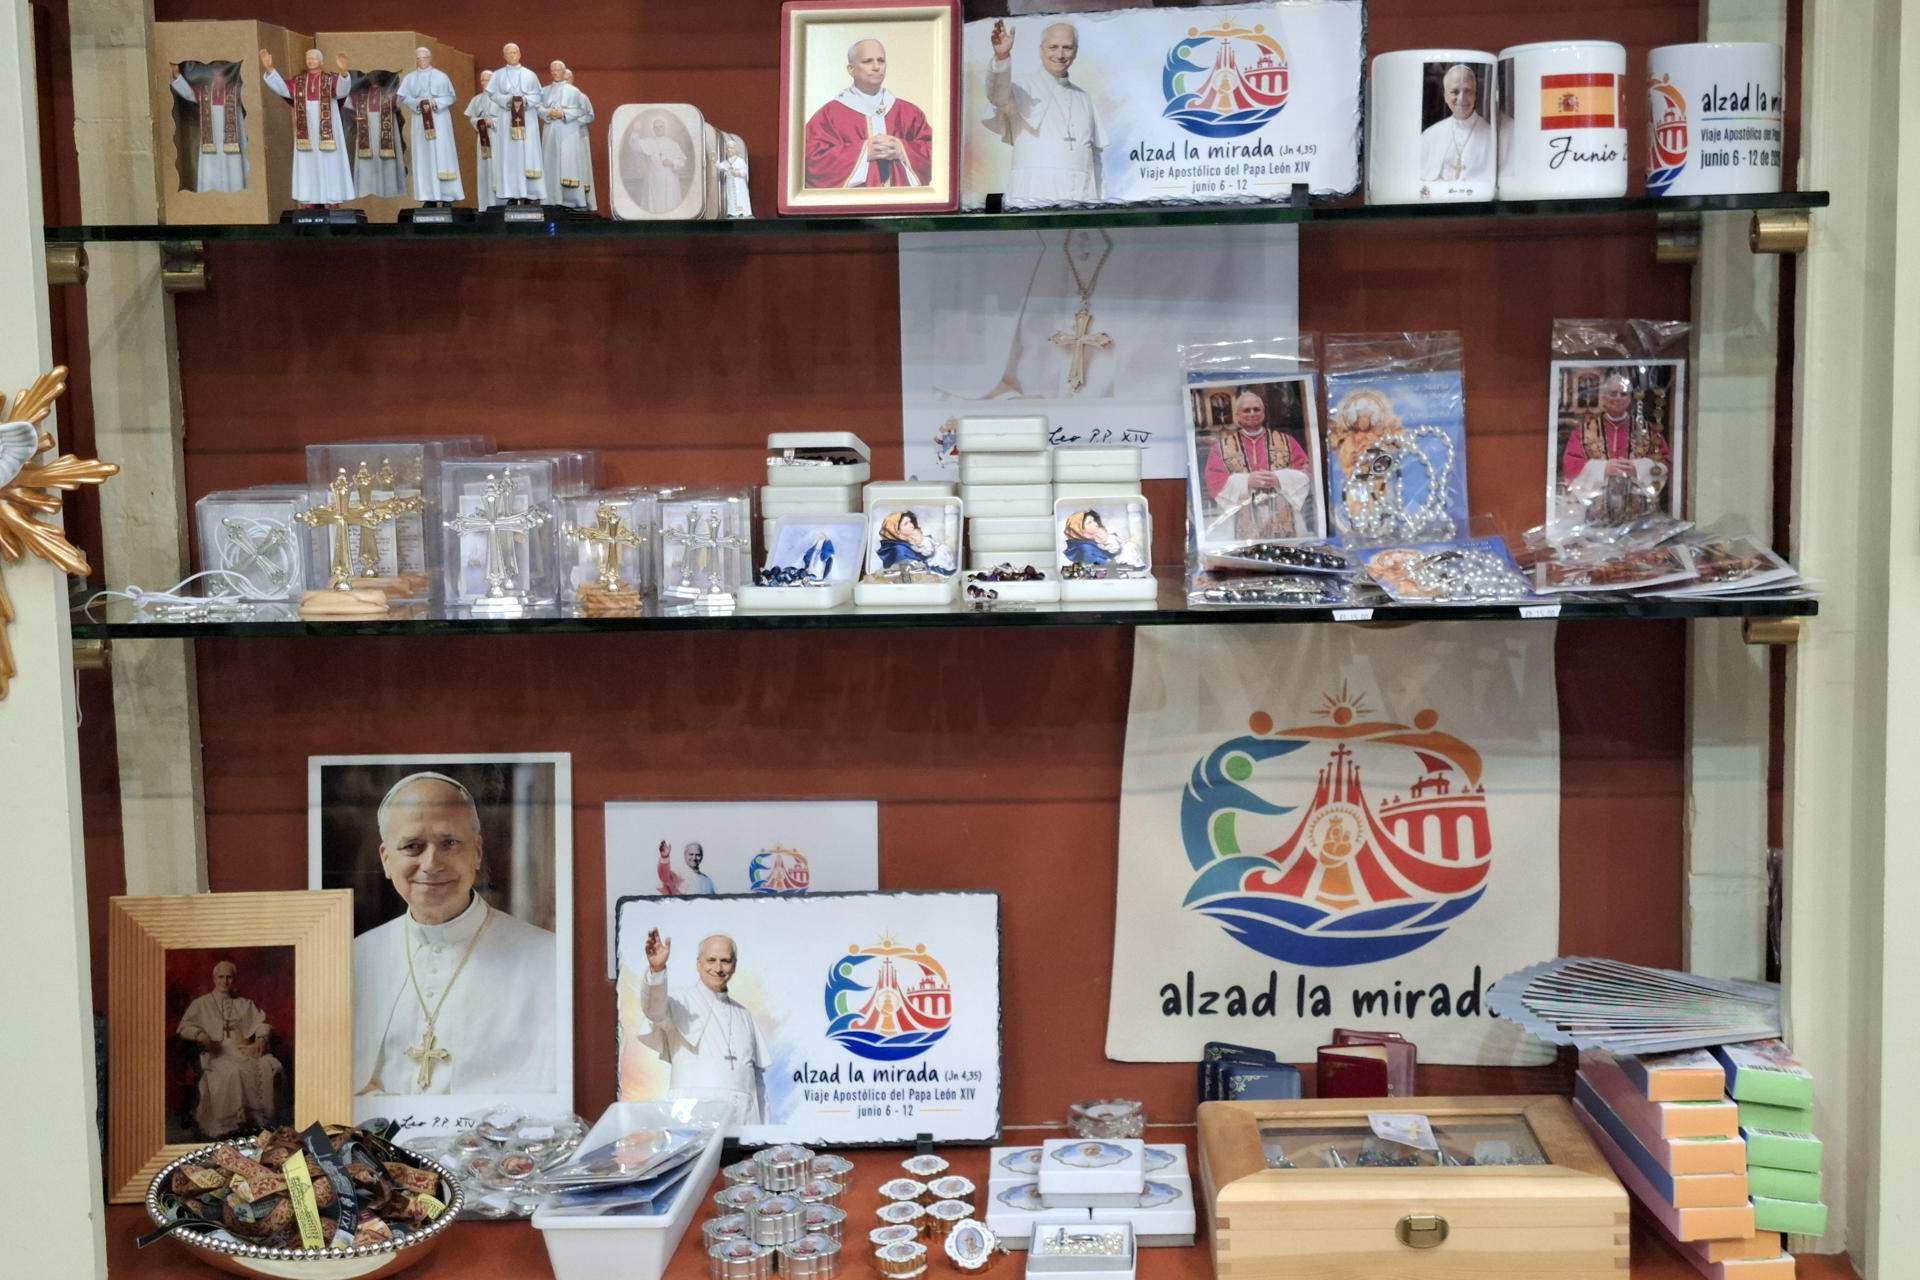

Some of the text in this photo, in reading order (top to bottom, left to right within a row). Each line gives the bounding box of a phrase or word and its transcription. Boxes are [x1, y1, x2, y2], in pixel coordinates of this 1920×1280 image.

[1702, 82, 1750, 112] alzad
[1757, 83, 1767, 112] la
[1701, 129, 1721, 142] Viaje
[1130, 137, 1317, 161] alzad la mirada (Jn 4,35)
[1549, 136, 1618, 169] Junio
[1701, 149, 1730, 169] junio
[1733, 150, 1739, 166] 6
[1749, 150, 1758, 166] 12
[1140, 161, 1310, 181] Viaje Apostólico del Papa León XIV
[1192, 180, 1215, 194] junio
[1220, 180, 1225, 191] 6
[1237, 179, 1248, 190] 12
[1049, 427, 1081, 445] Leo
[1121, 429, 1154, 443] XIV
[1160, 970, 1278, 1018] alzad
[1298, 974, 1332, 1018] la
[793, 1062, 982, 1084] alzad la mirada (Jn 4,35)
[804, 1087, 976, 1103] Viaje Apostólico del Papa León XIV
[858, 1105, 881, 1119] junio
[885, 1105, 891, 1116] 6
[903, 1104, 914, 1116] 12
[400, 1115, 426, 1129] Leo
